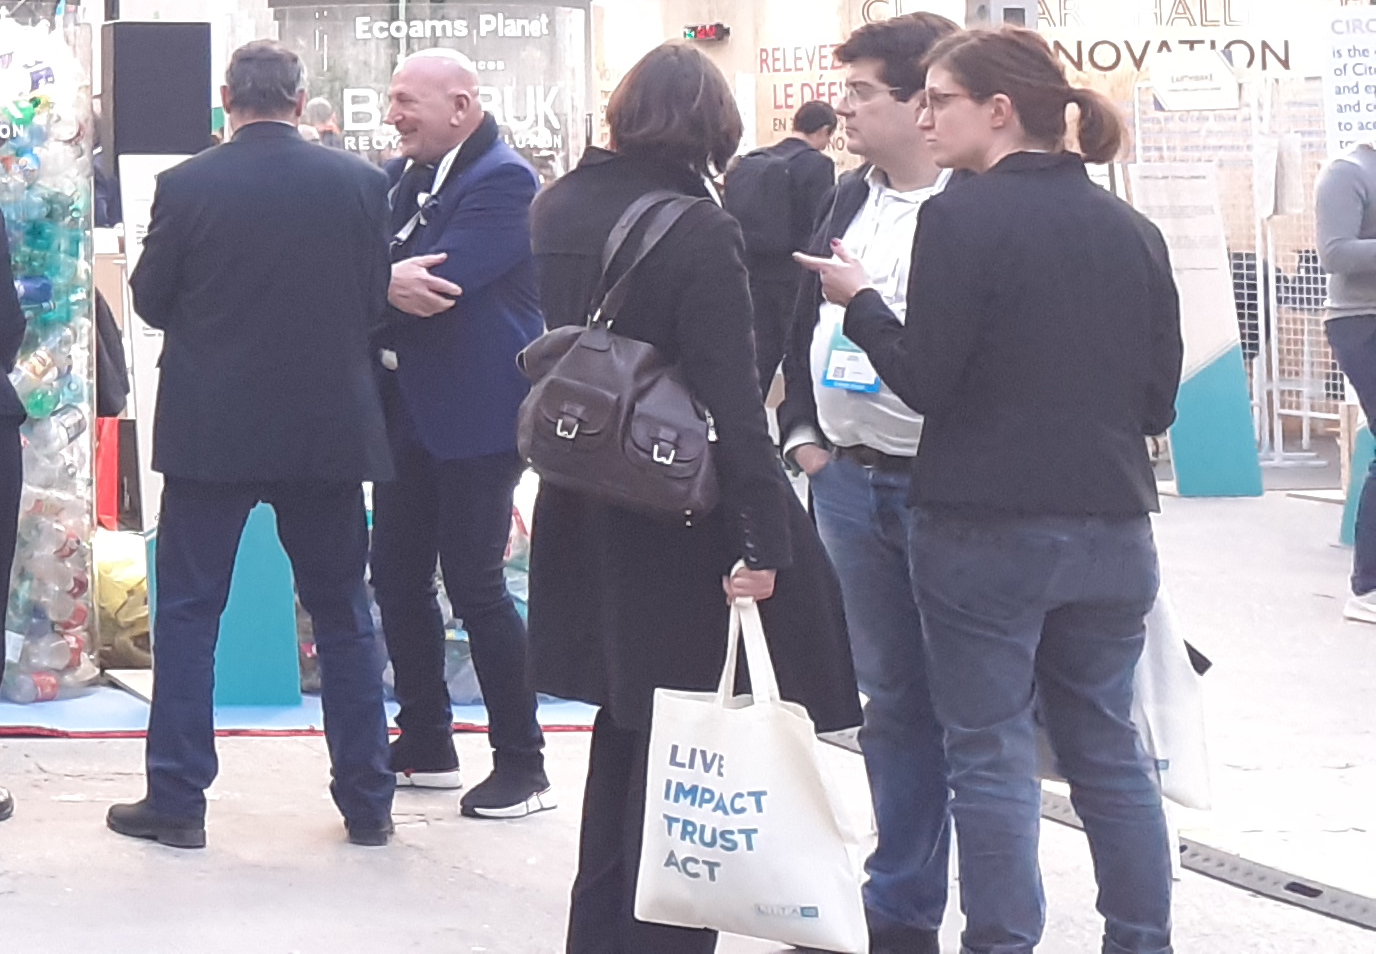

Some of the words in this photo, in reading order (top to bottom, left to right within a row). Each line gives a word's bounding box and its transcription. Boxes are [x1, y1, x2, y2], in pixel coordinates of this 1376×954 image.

[355, 15, 469, 39] Ecoams
[479, 13, 549, 38] Planet
[760, 43, 846, 73] RELEVEZ
[1347, 45, 1369, 58] the
[1334, 63, 1348, 77] of
[773, 83, 793, 109] LE
[1335, 81, 1359, 96] and
[1337, 100, 1360, 113] and
[1338, 121, 1353, 132] to
[344, 135, 402, 150] RECY
[668, 744, 724, 777] LIVE
[664, 779, 767, 816] IMPACT
[663, 813, 759, 852] TRUST
[663, 850, 721, 882] ACT
